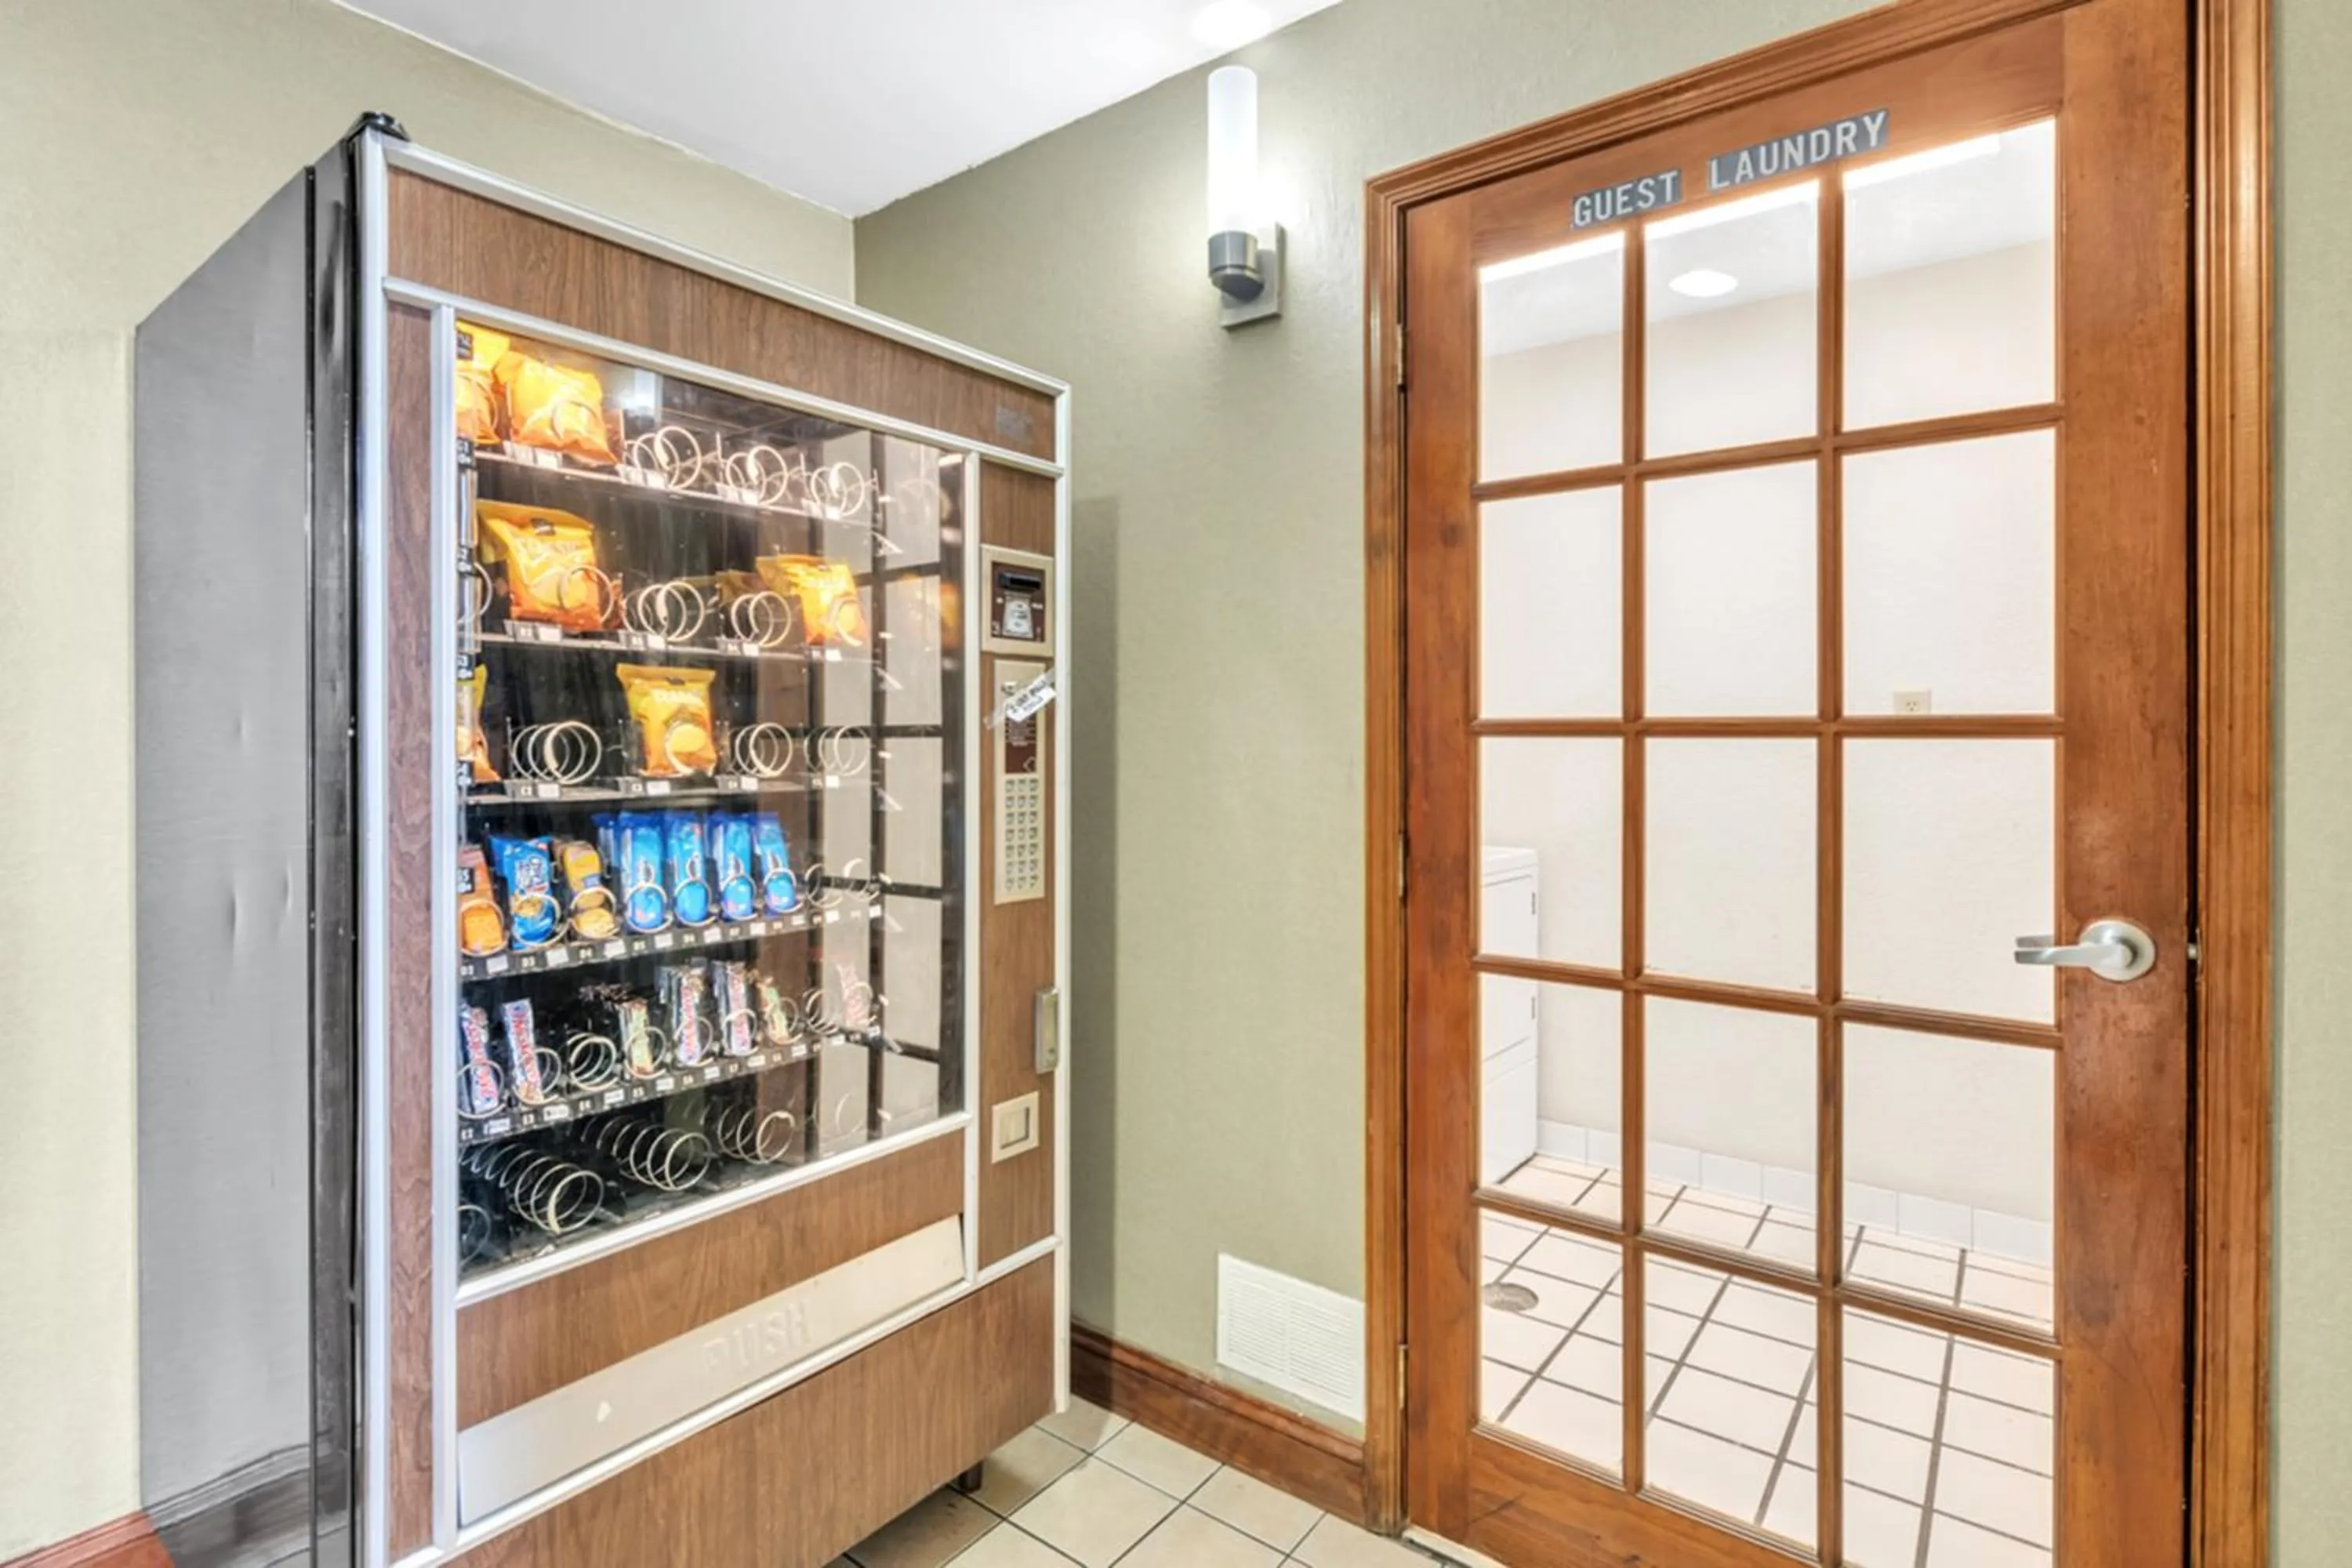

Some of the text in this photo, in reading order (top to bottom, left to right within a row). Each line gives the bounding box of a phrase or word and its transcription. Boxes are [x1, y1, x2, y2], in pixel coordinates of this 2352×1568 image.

[1573, 111, 1886, 227] GUEST LAUNDRY
[702, 1298, 812, 1369] PUSH
